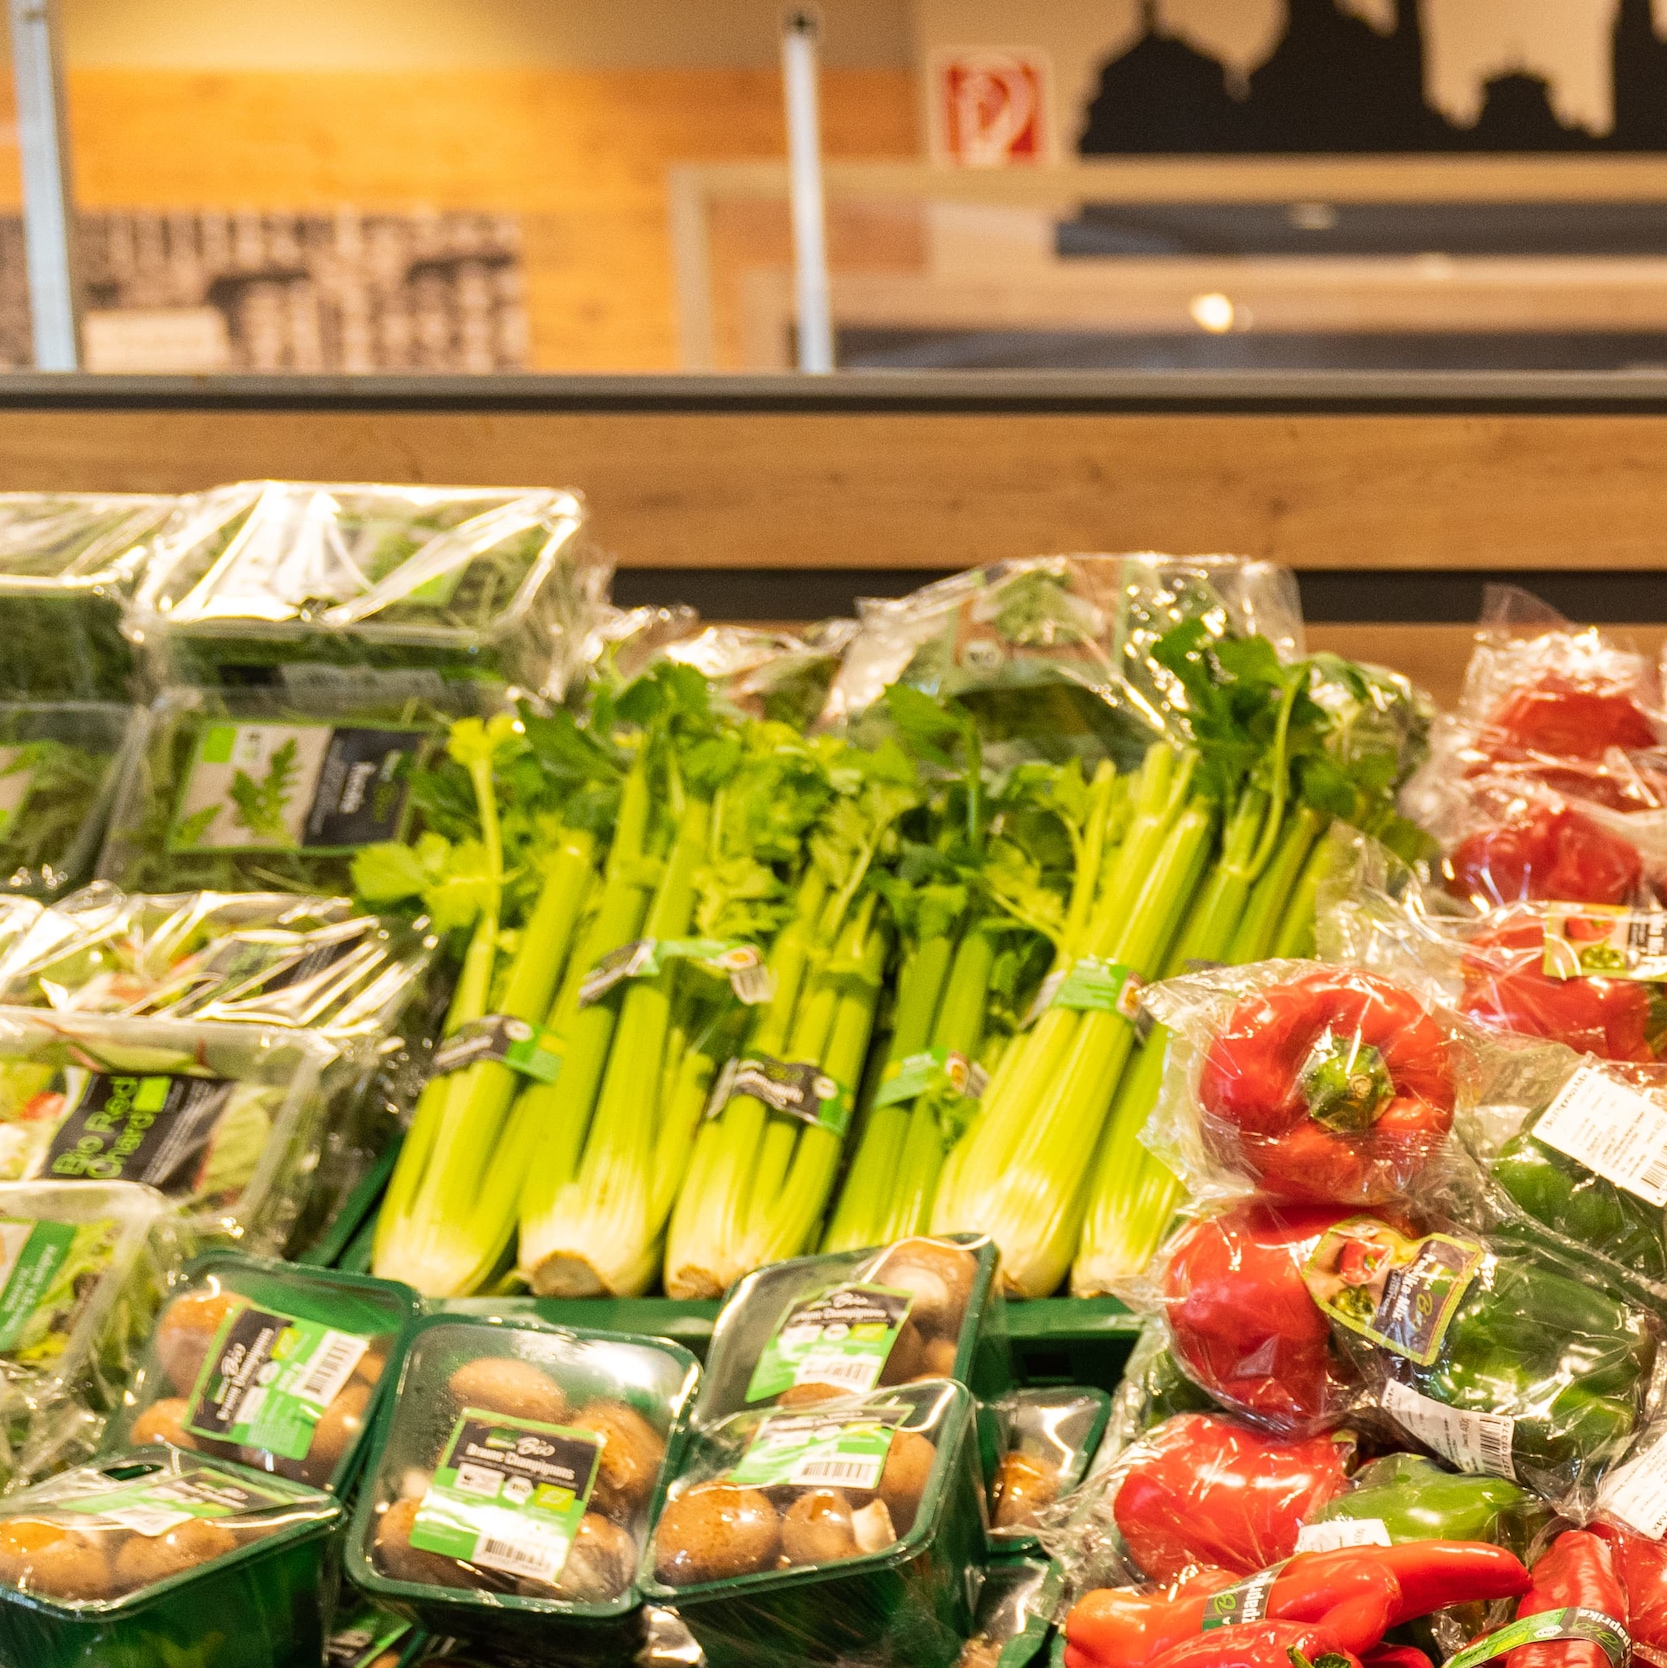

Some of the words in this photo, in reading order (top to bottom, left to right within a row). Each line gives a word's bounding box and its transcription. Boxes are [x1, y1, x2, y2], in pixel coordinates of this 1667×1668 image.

[51, 1130, 104, 1177] Bio
[89, 1076, 138, 1132] Red
[220, 1342, 247, 1377] Bio
[517, 1436, 556, 1457] Bio
